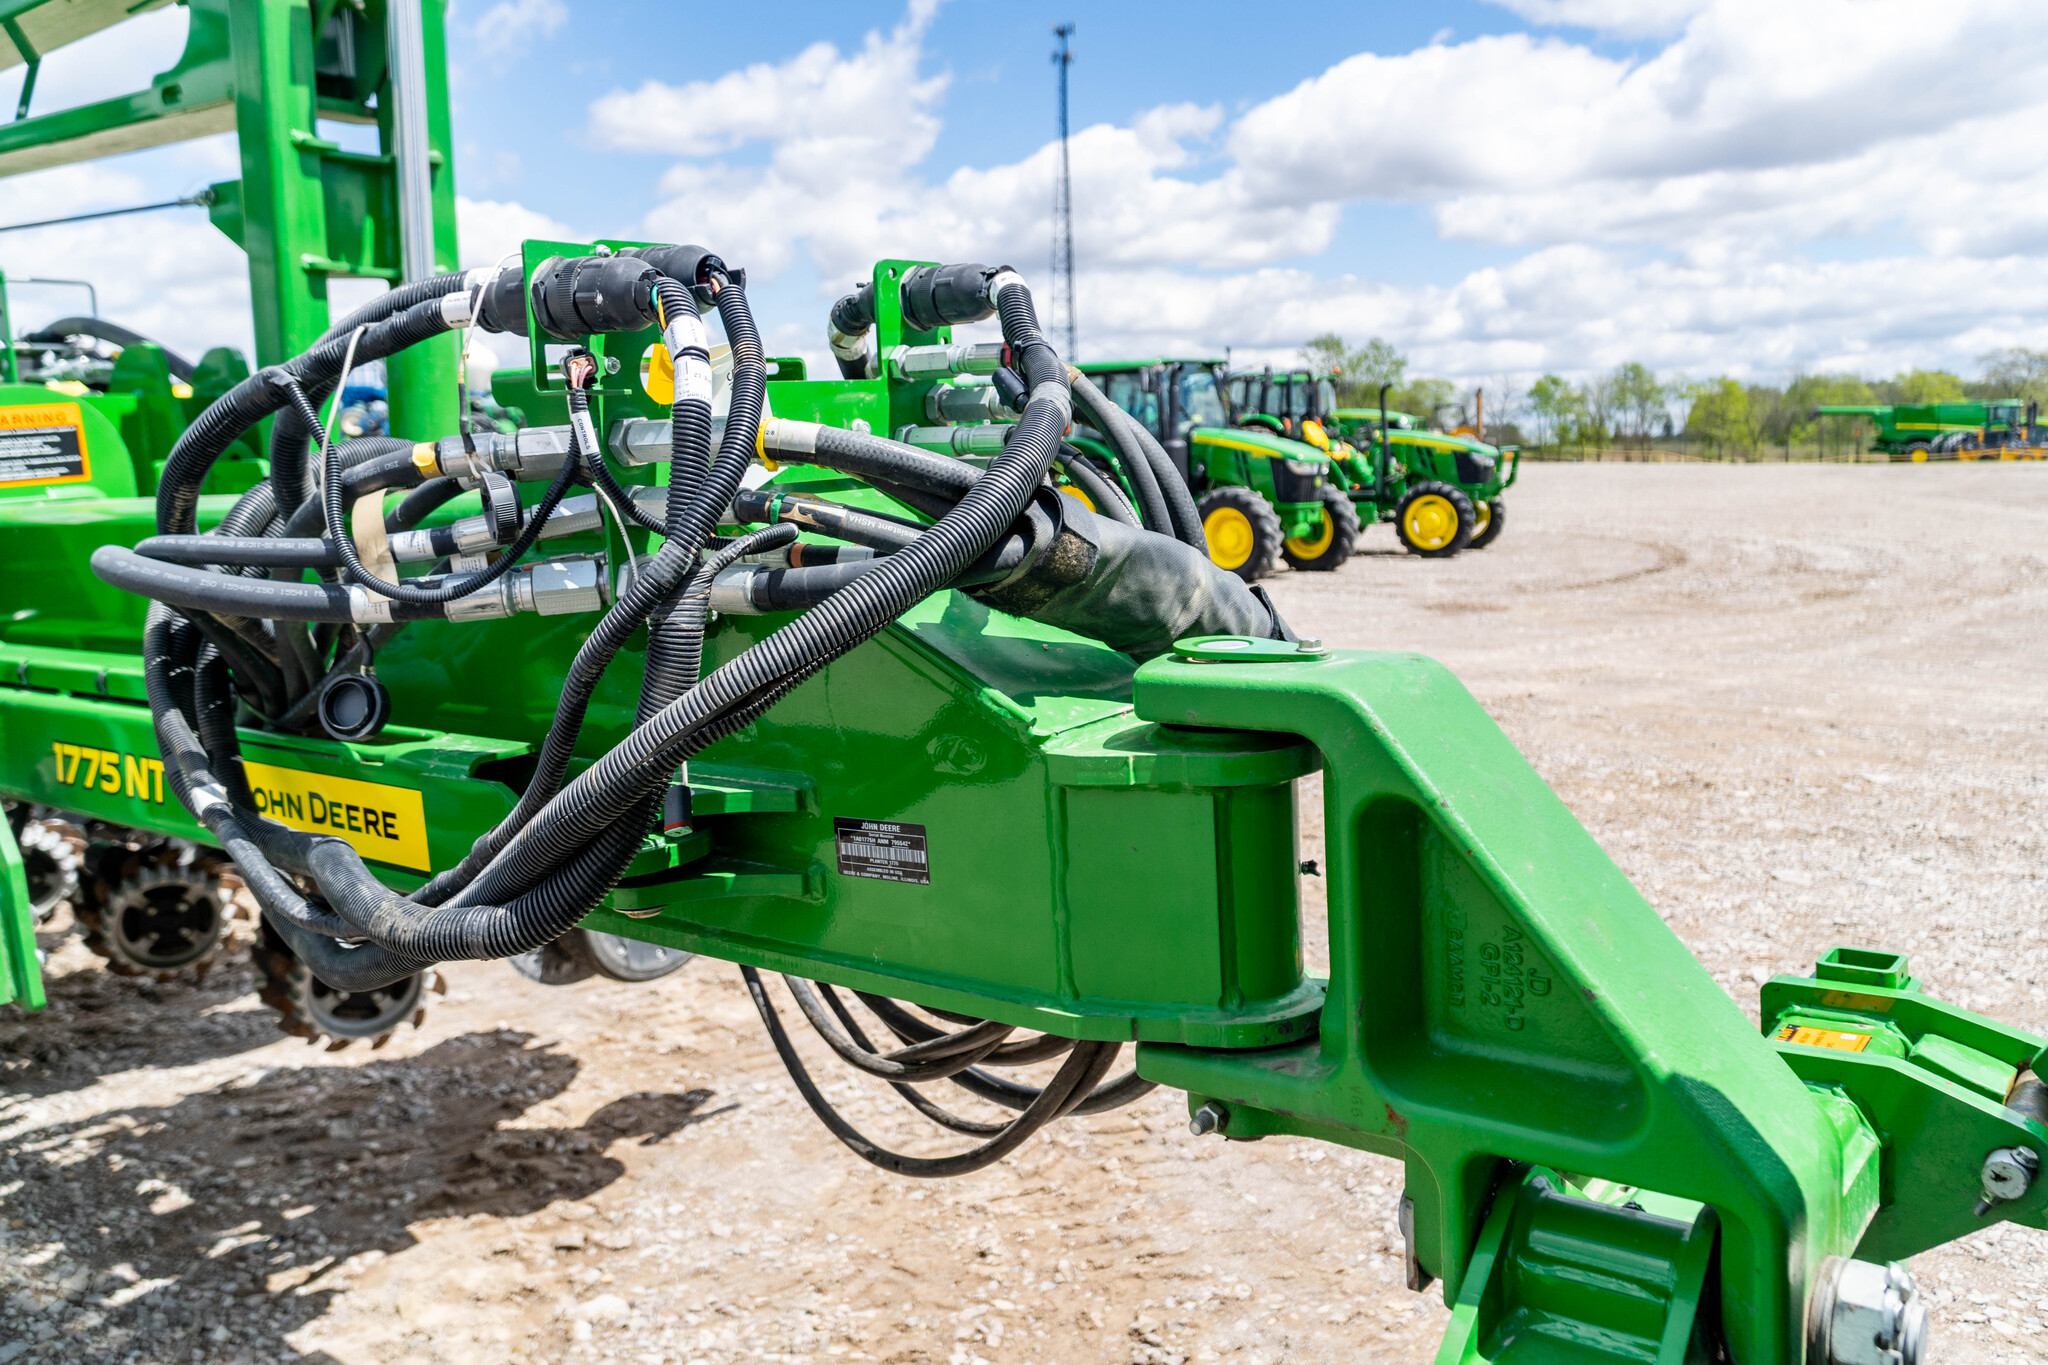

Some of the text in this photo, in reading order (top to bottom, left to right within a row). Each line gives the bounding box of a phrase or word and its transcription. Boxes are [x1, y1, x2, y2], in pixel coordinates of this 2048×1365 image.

[0, 411, 67, 426] ARNING
[577, 418, 591, 450] CONTROLS
[849, 514, 876, 528] MSHA
[52, 741, 165, 803] 1775 NT
[253, 787, 399, 841] OHN DEERE
[861, 822, 901, 833] JOHN DEERE
[1502, 925, 1525, 1032] A124121-D
[1527, 967, 1552, 997] JD
